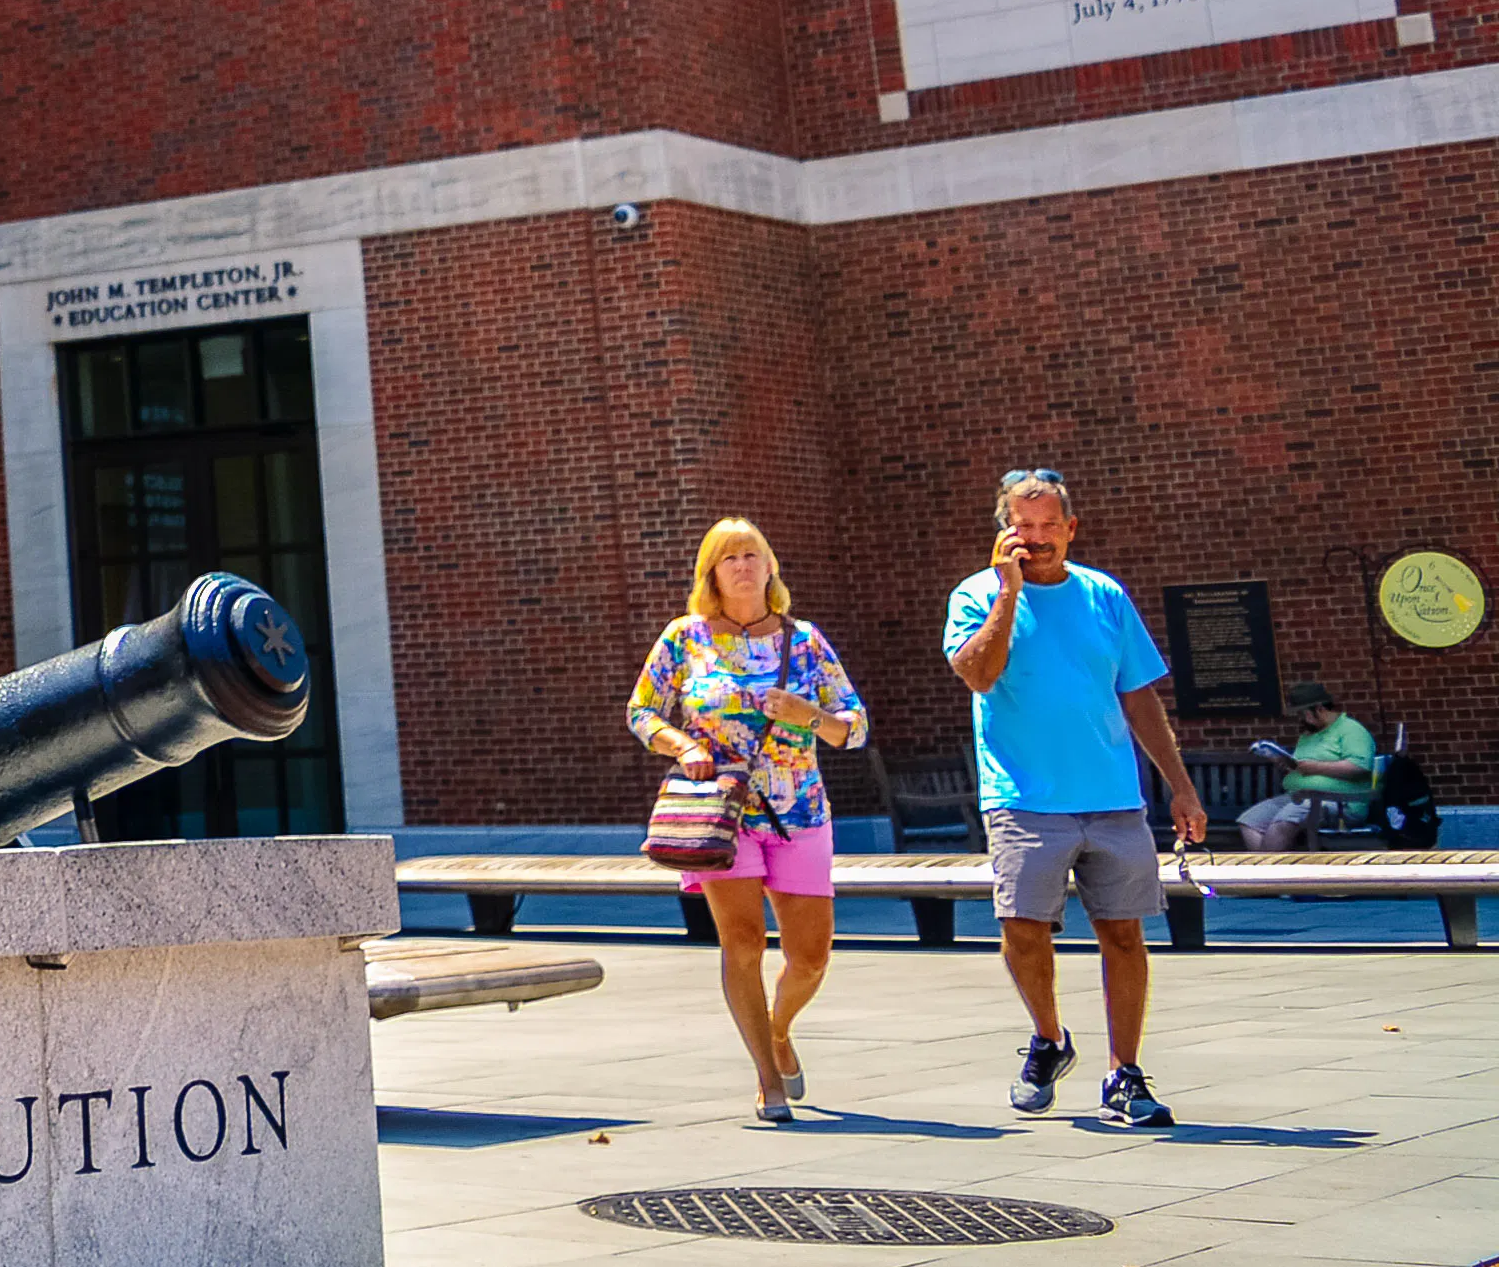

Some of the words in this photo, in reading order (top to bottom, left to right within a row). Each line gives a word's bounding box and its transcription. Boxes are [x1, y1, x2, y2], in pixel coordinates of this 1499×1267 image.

[46, 284, 99, 312] JOHN
[108, 283, 130, 299] M.
[135, 264, 266, 296] TEMPLETON,
[272, 260, 303, 281] JR.
[68, 298, 188, 327] EDUCATION
[197, 287, 280, 311] CENTER
